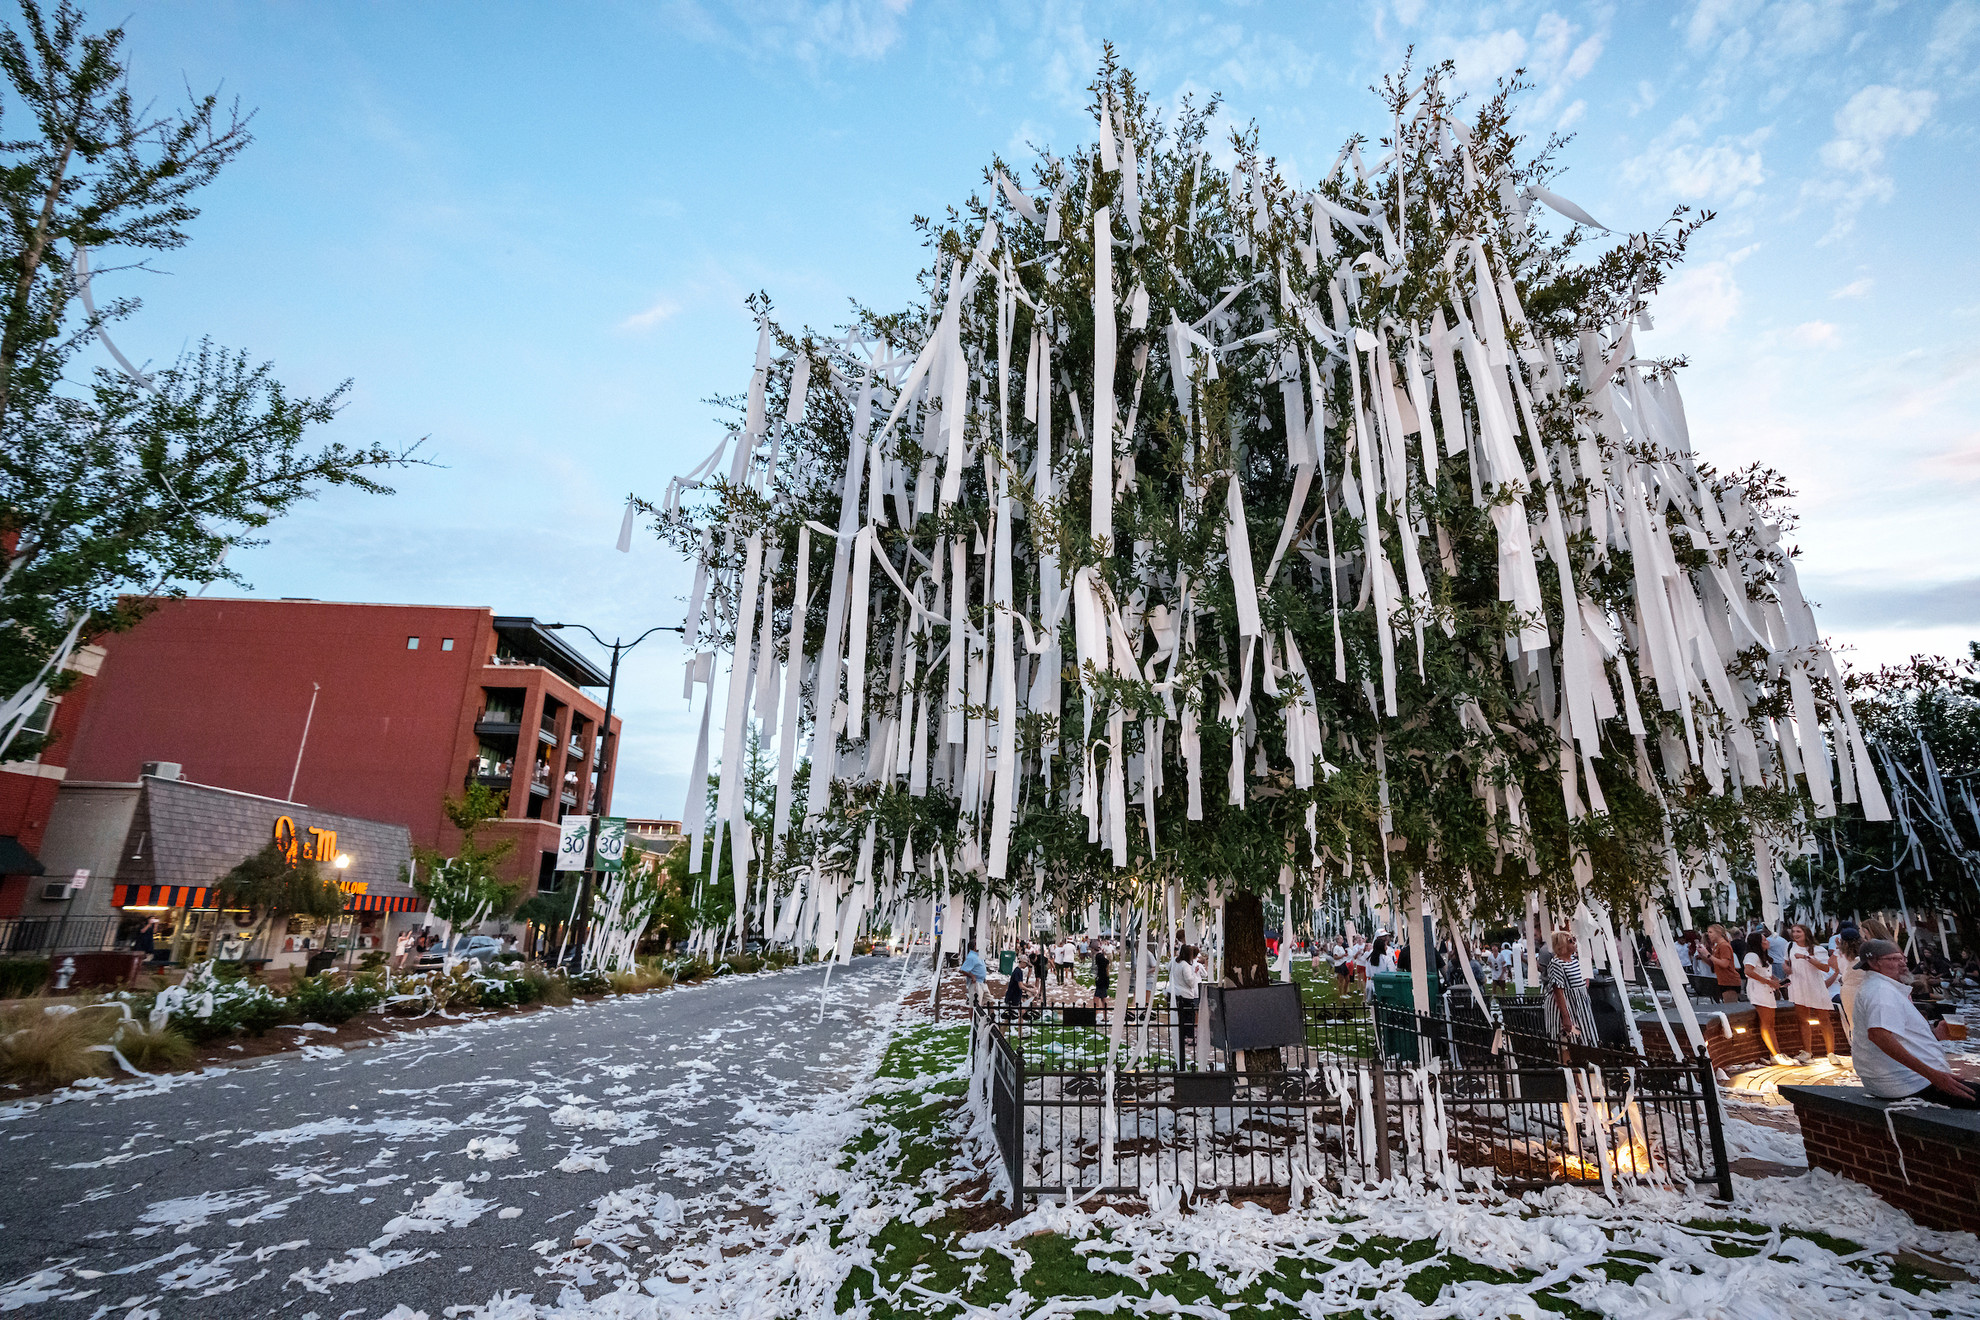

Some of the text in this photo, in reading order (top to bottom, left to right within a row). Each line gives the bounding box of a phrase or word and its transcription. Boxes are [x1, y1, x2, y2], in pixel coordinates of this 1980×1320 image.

[303, 842, 313, 860] &
[308, 825, 341, 862] M
[562, 836, 585, 853] 30
[598, 837, 621, 854] 30
